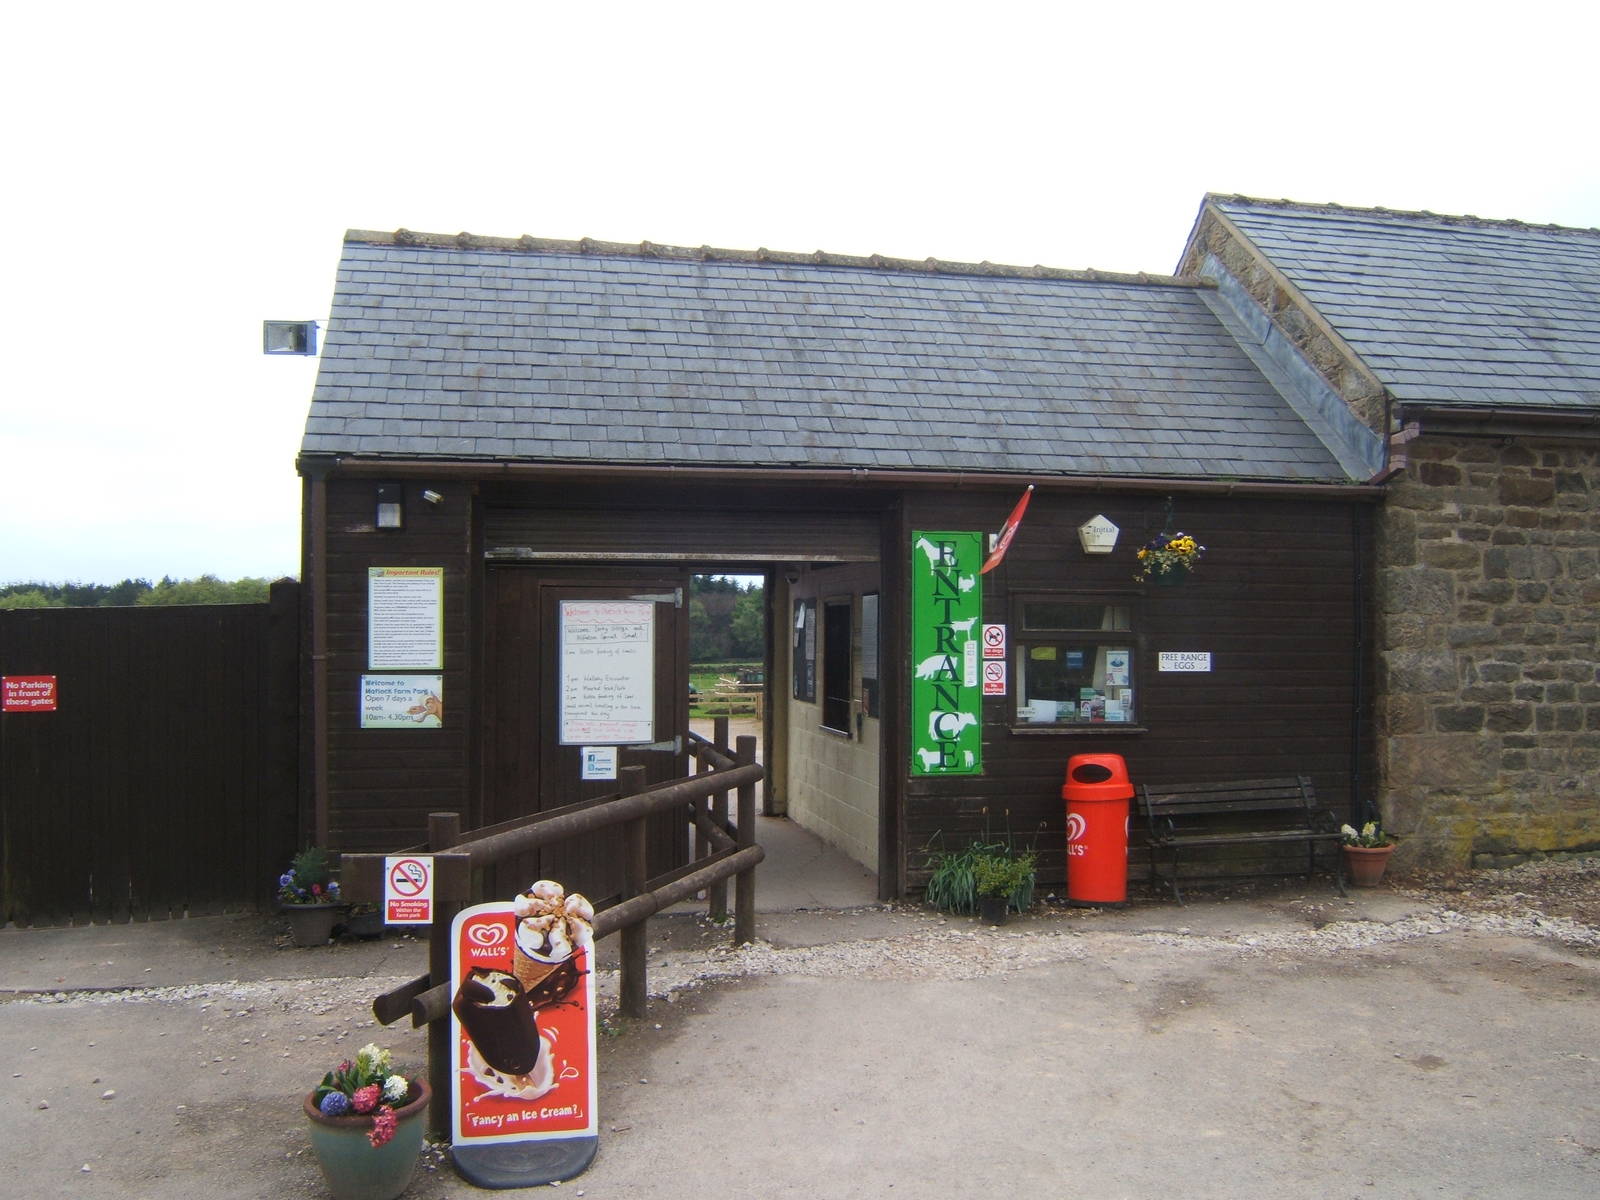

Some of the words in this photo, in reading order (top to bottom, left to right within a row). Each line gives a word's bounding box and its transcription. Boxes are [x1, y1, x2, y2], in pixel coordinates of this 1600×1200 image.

[932, 540, 963, 768] ENTRANCE
[1161, 653, 1179, 661] FREE
[1180, 653, 1208, 661] RANGE
[1174, 662, 1195, 670] EGGS
[21, 681, 53, 690] Parking
[365, 695, 385, 703] Open
[392, 695, 407, 703] days
[1067, 844, 1084, 856] LL'S
[470, 947, 506, 957] WALL'S
[471, 1113, 504, 1128] Fancy
[507, 1112, 519, 1122] an
[521, 1110, 538, 1121] Ice
[540, 1104, 578, 1119] Cream?
